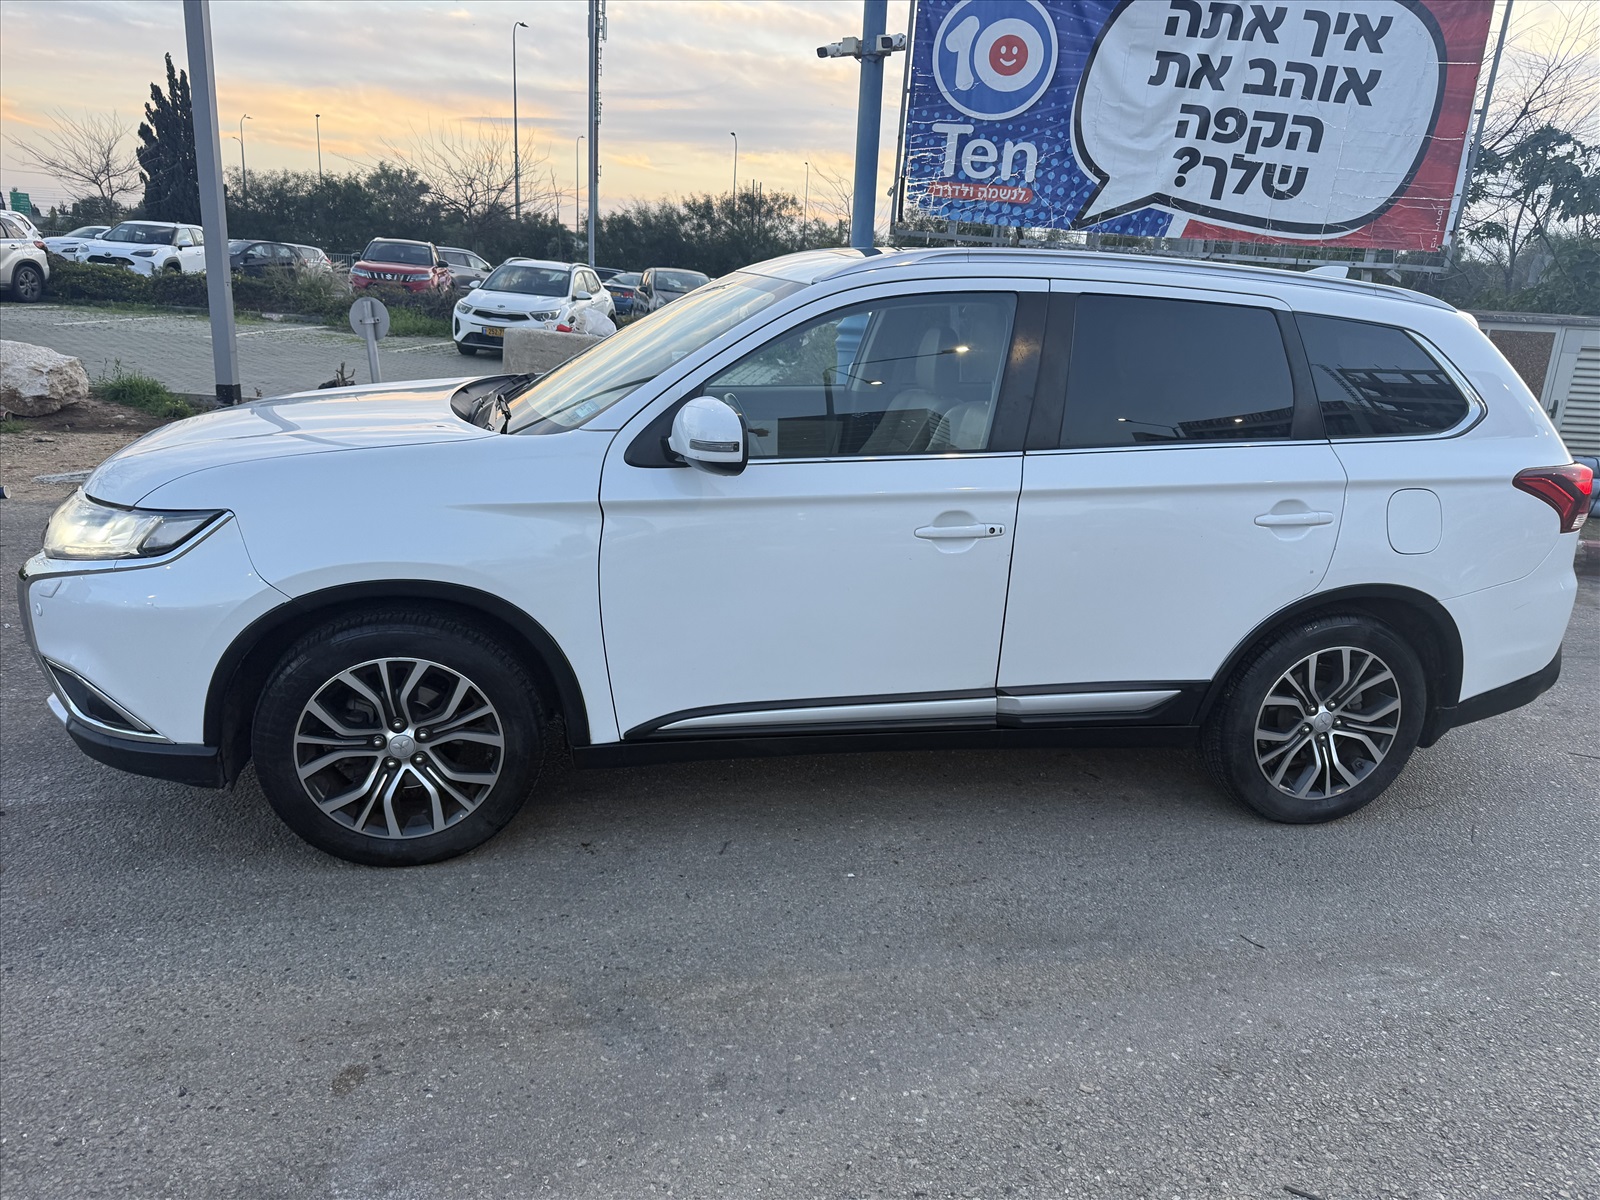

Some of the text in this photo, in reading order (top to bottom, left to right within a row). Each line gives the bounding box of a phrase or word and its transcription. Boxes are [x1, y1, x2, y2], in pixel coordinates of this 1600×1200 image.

[1164, 0, 1394, 57] איך אתה
[1147, 51, 1382, 106] אוהב את
[932, 123, 1038, 182] Ten
[1174, 104, 1324, 154] הקפה
[977, 185, 1027, 201] לנשמה
[1173, 147, 1309, 200] שלך?
